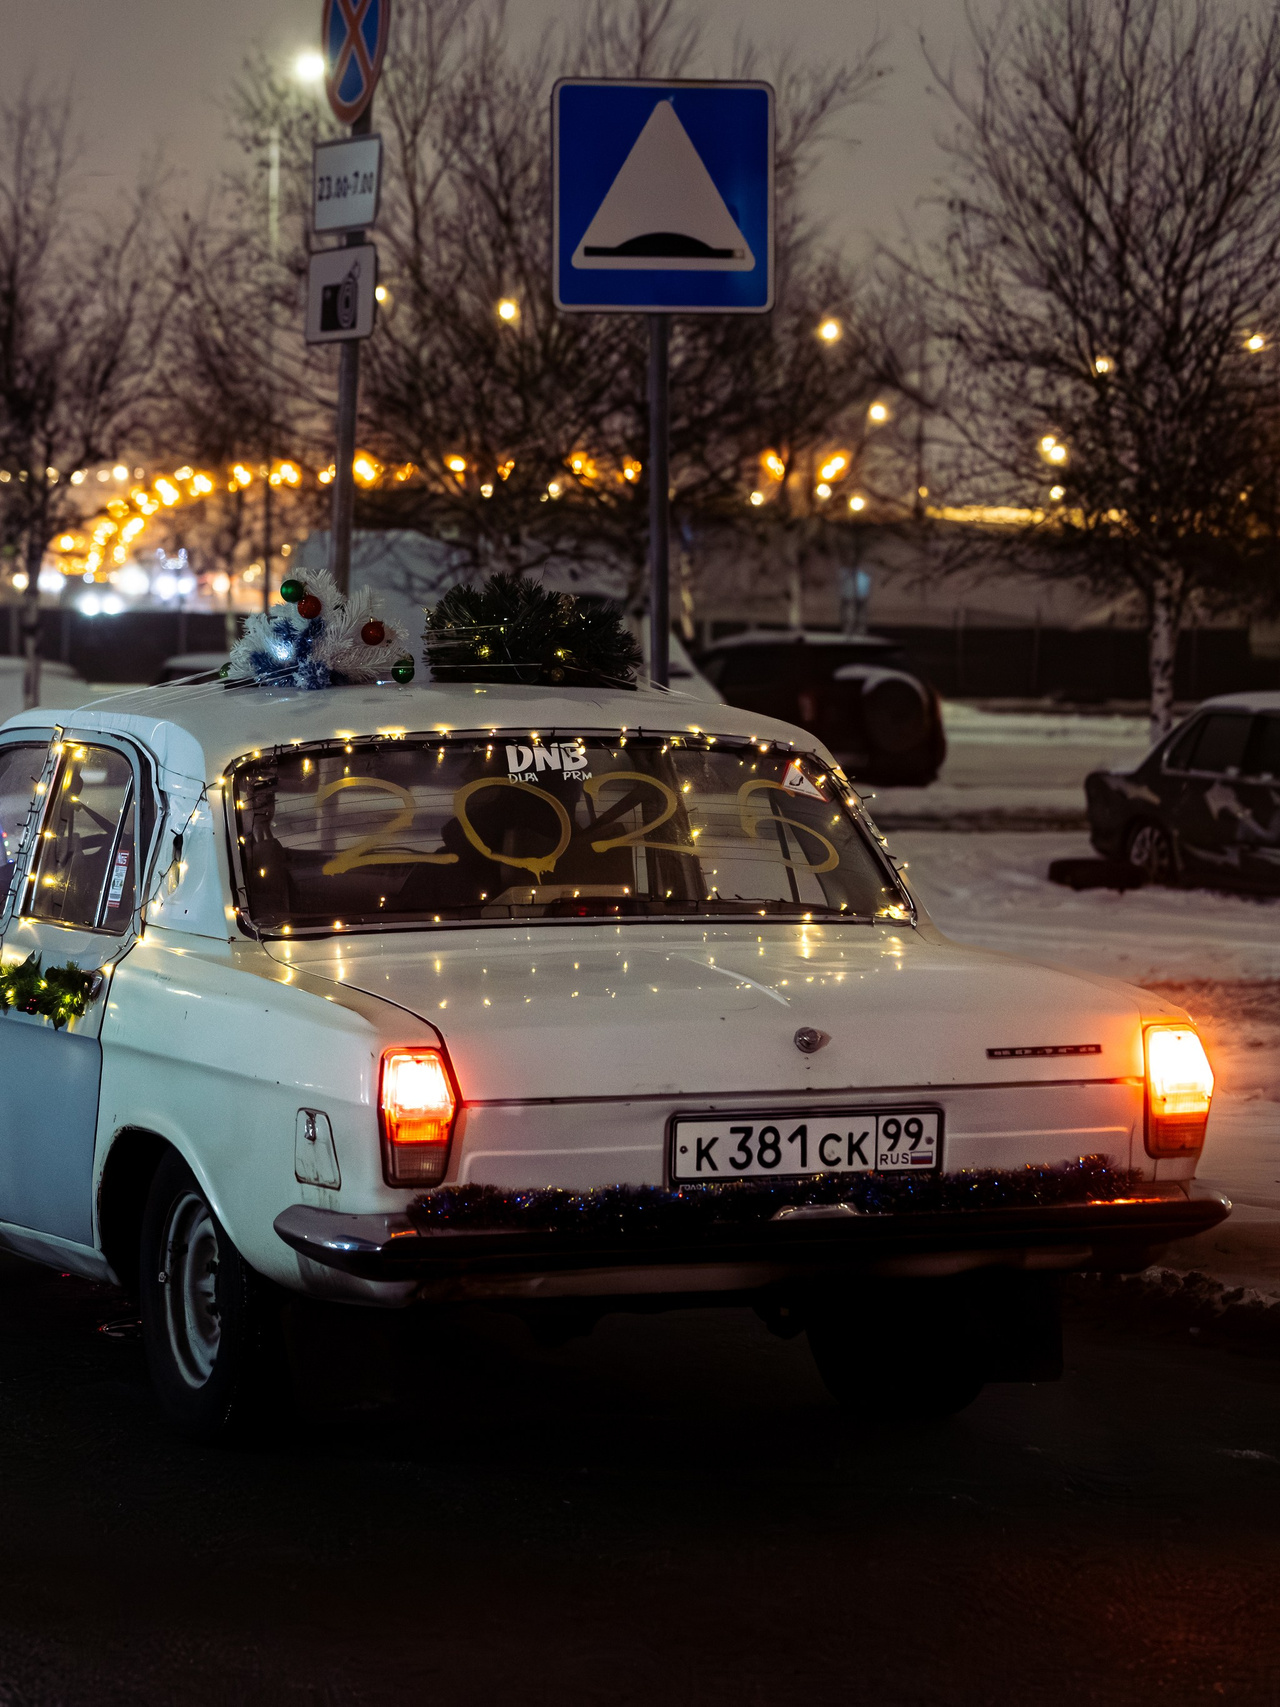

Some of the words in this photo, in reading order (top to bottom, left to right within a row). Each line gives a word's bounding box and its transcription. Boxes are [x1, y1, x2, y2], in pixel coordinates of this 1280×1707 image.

[505, 742, 588, 772] DNB
[882, 1117, 924, 1152] 99
[879, 1152, 910, 1165] RUS
